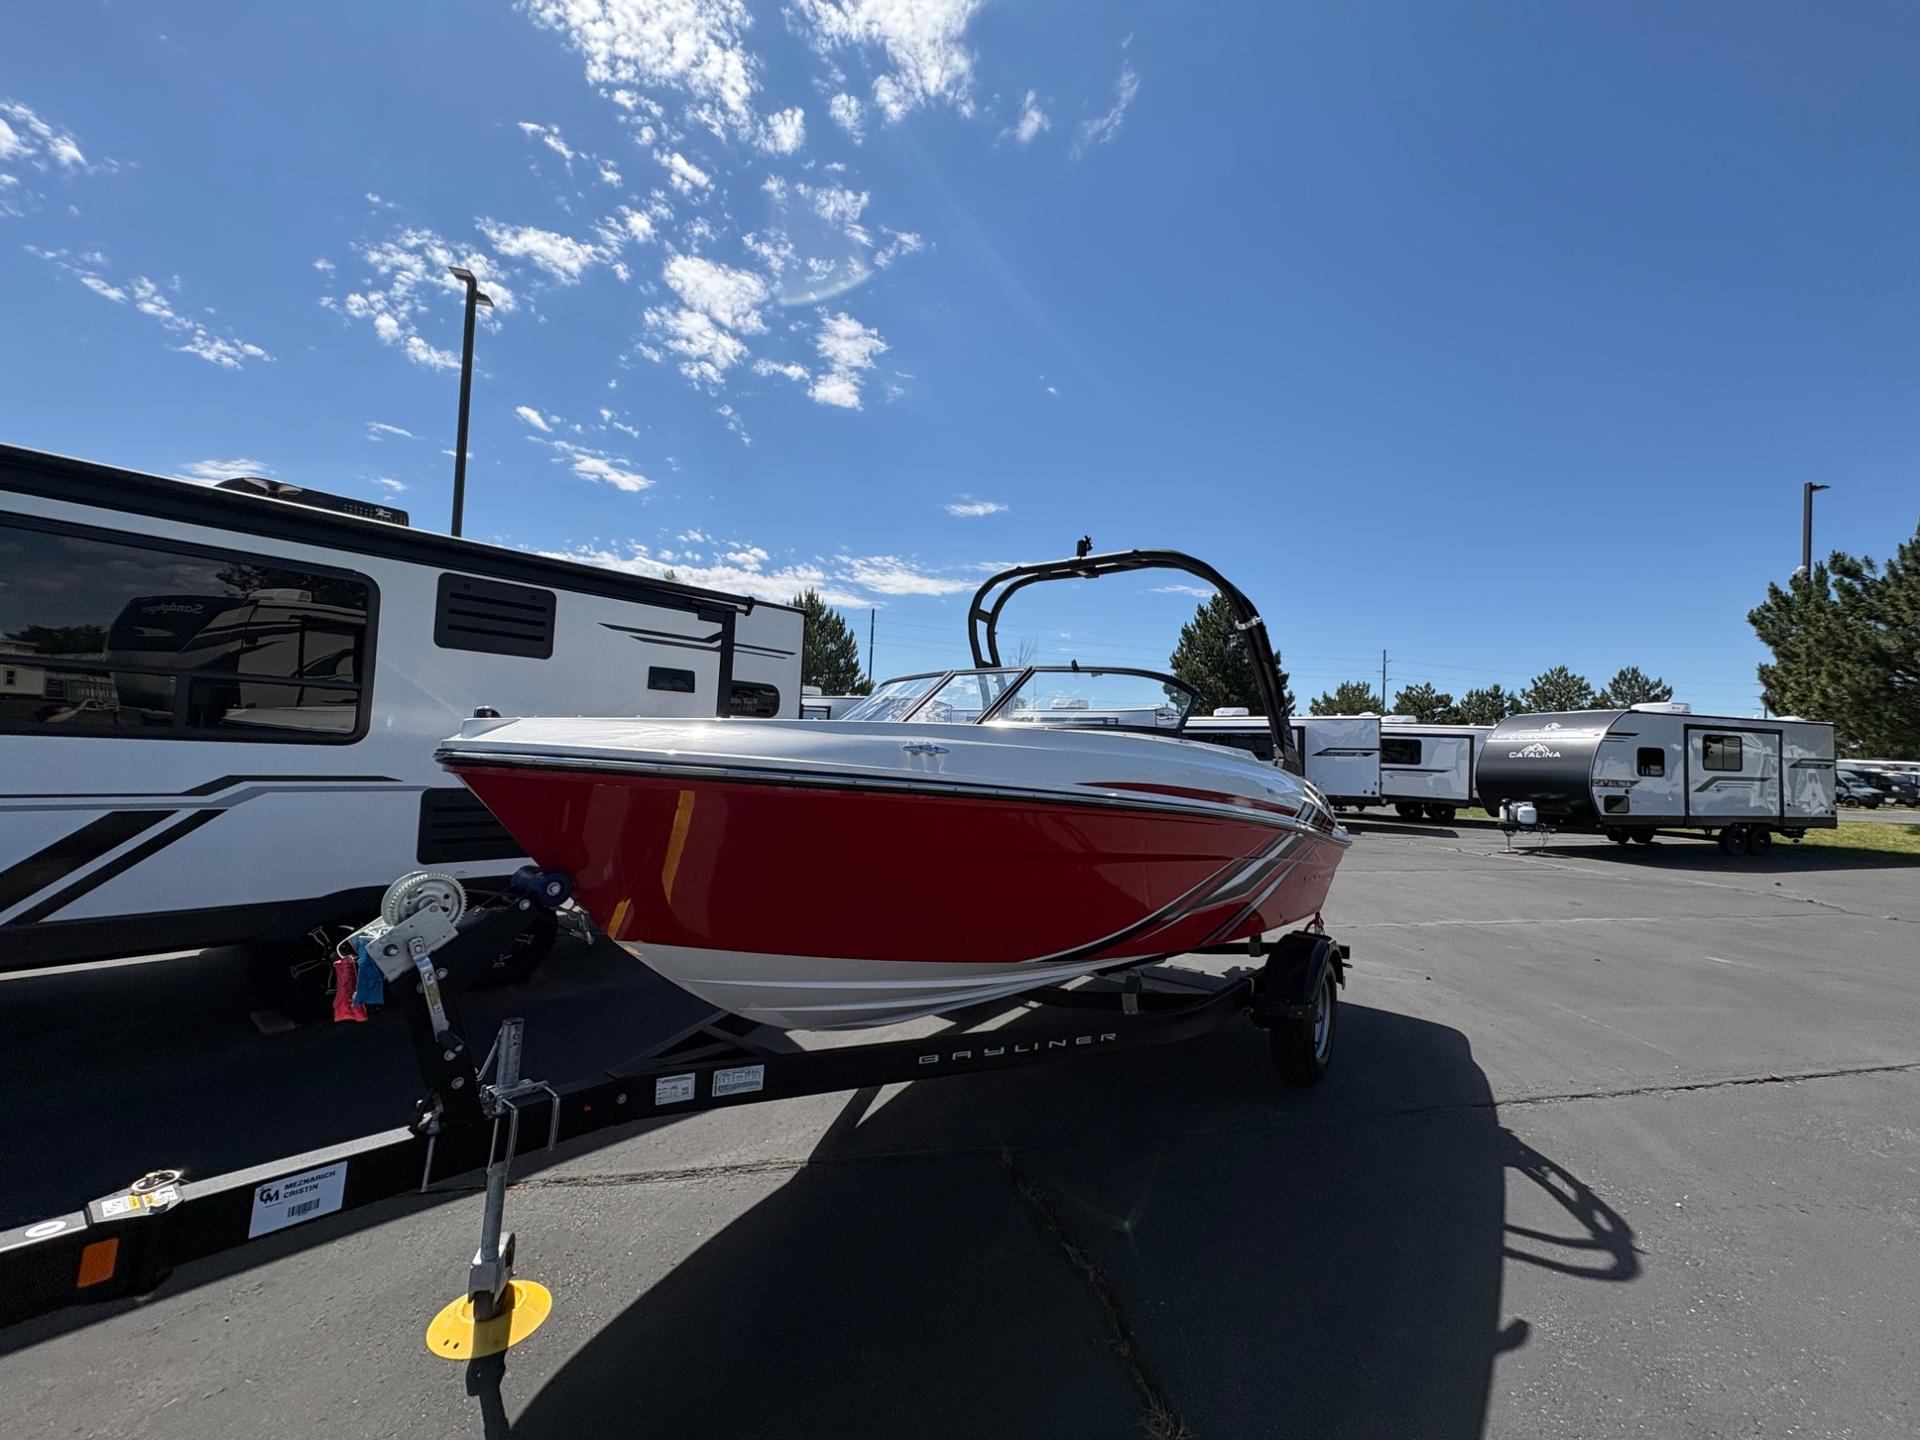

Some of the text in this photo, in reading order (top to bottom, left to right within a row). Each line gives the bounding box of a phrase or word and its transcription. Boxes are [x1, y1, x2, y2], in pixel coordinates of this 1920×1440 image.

[918, 1032, 1117, 1065] BAYLINER
[284, 1170, 336, 1190] MEZNARICH
[283, 1183, 319, 1199] CRISTIN
